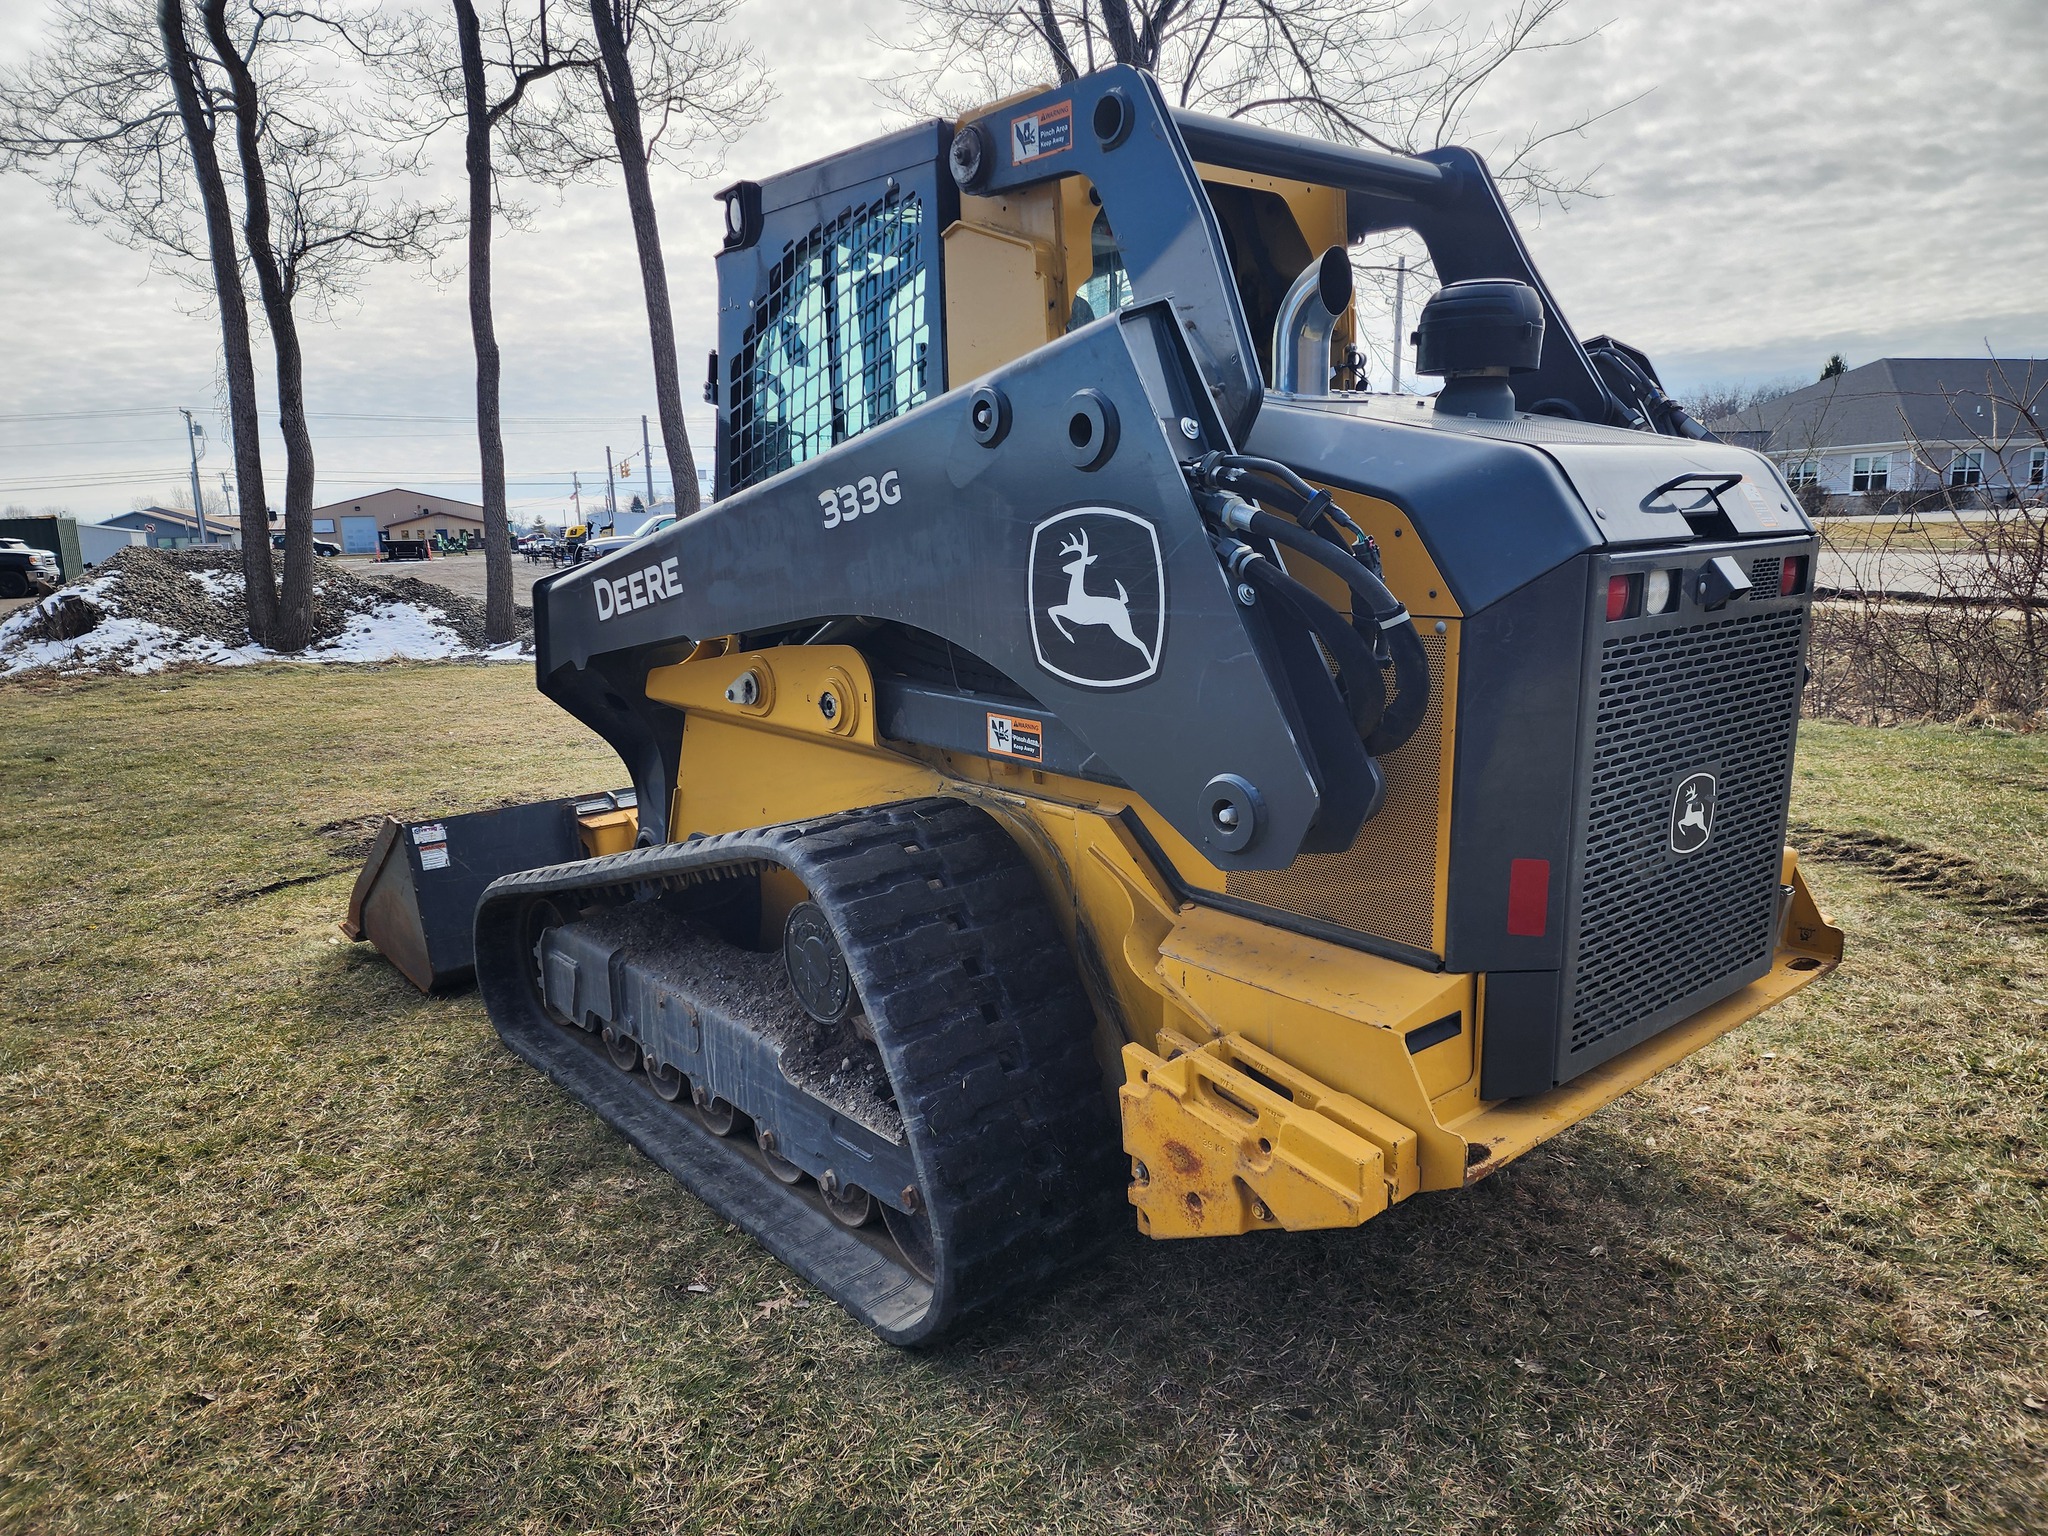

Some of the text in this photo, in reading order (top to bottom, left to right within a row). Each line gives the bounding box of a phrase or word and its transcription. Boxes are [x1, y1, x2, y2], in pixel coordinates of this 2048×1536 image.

[1045, 106, 1069, 120] WARNING
[1040, 124, 1068, 139] Pinch Area
[1040, 135, 1065, 148] Keep Away
[817, 470, 902, 529] 333G
[593, 556, 683, 622] DEERE
[1018, 722, 1039, 732] WARNING
[1024, 746, 1035, 754] Away
